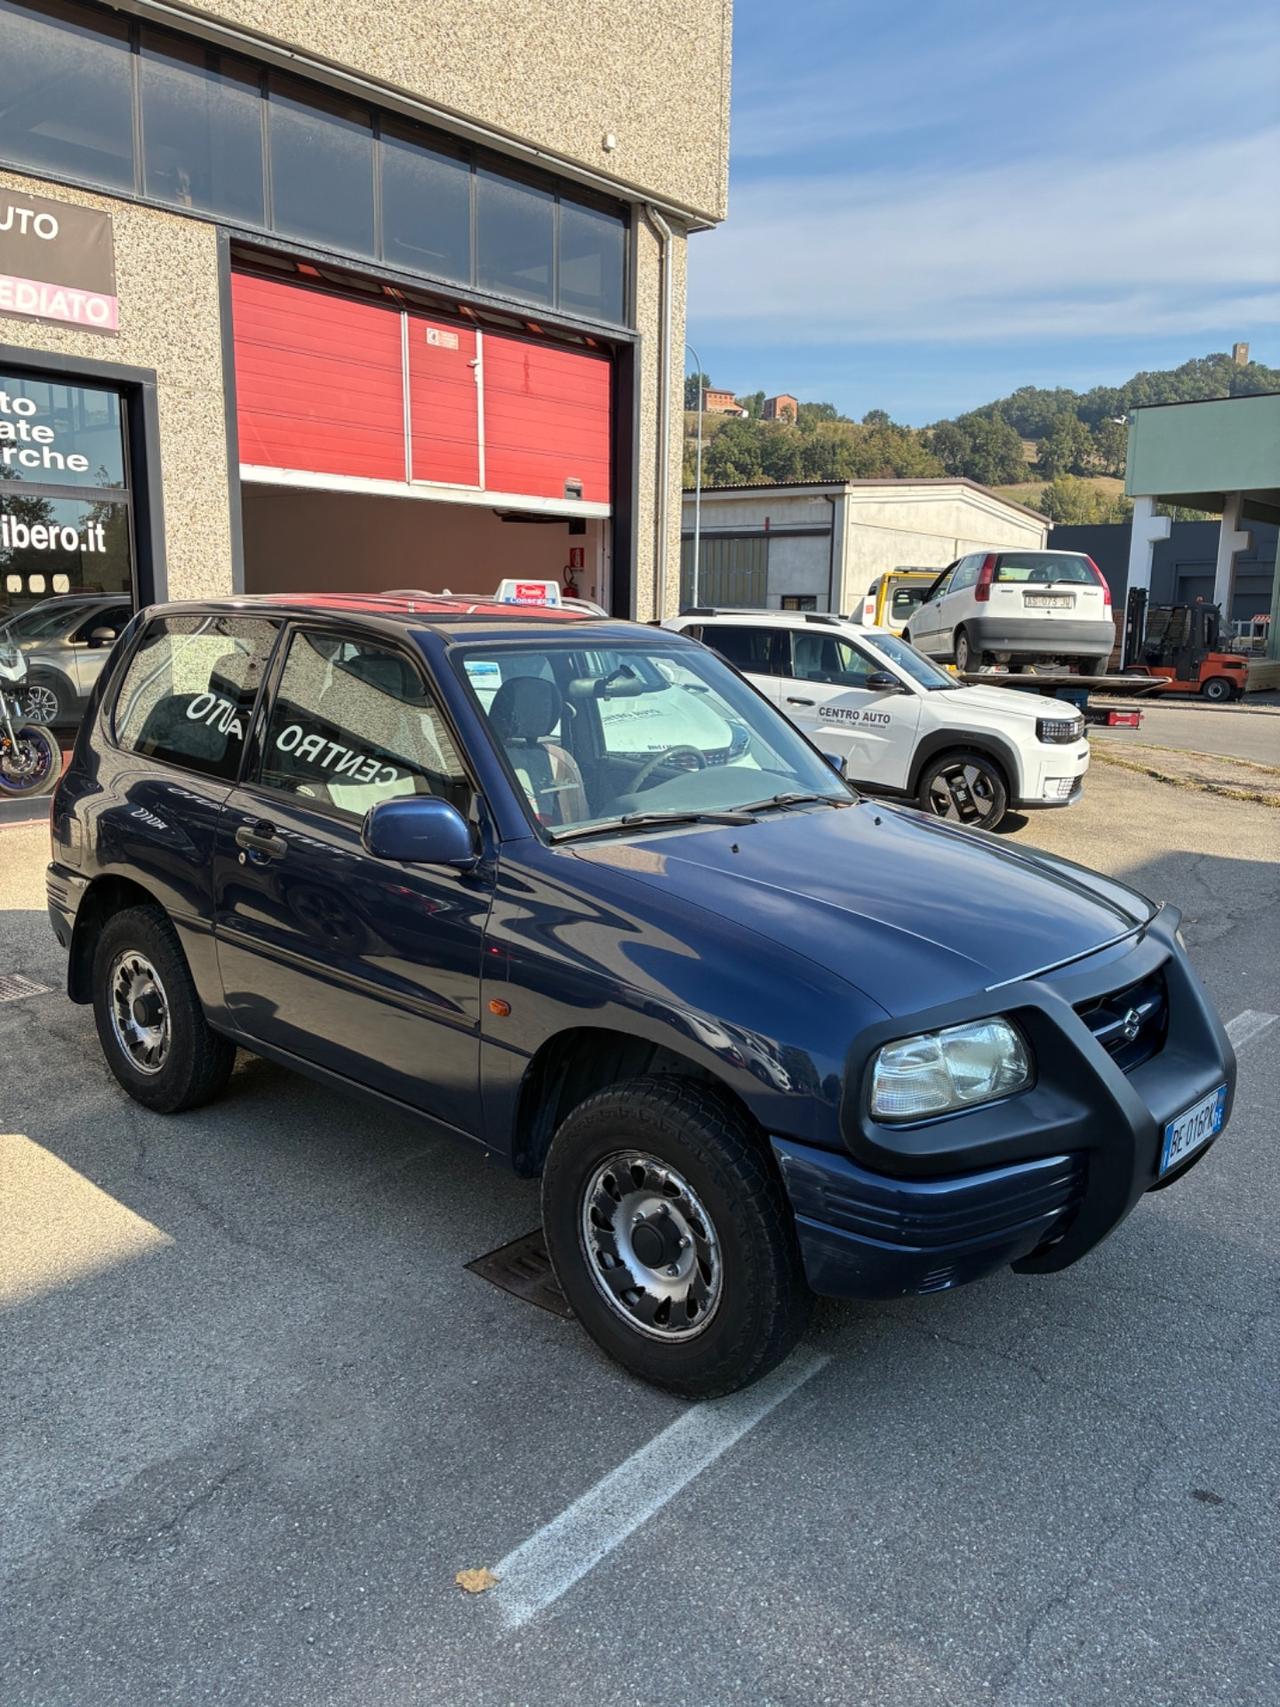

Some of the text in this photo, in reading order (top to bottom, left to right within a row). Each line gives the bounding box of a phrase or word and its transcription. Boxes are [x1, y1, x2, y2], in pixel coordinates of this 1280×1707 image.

[0, 206, 58, 239] UTO
[0, 280, 109, 323] EDIATO
[0, 391, 36, 416] to
[0, 419, 54, 444] ate
[2, 446, 89, 472] rche
[1, 514, 106, 552] ibero.it
[818, 706, 860, 720] CENTRO
[863, 712, 891, 724] AUTO
[1170, 1124, 1185, 1158] BE
